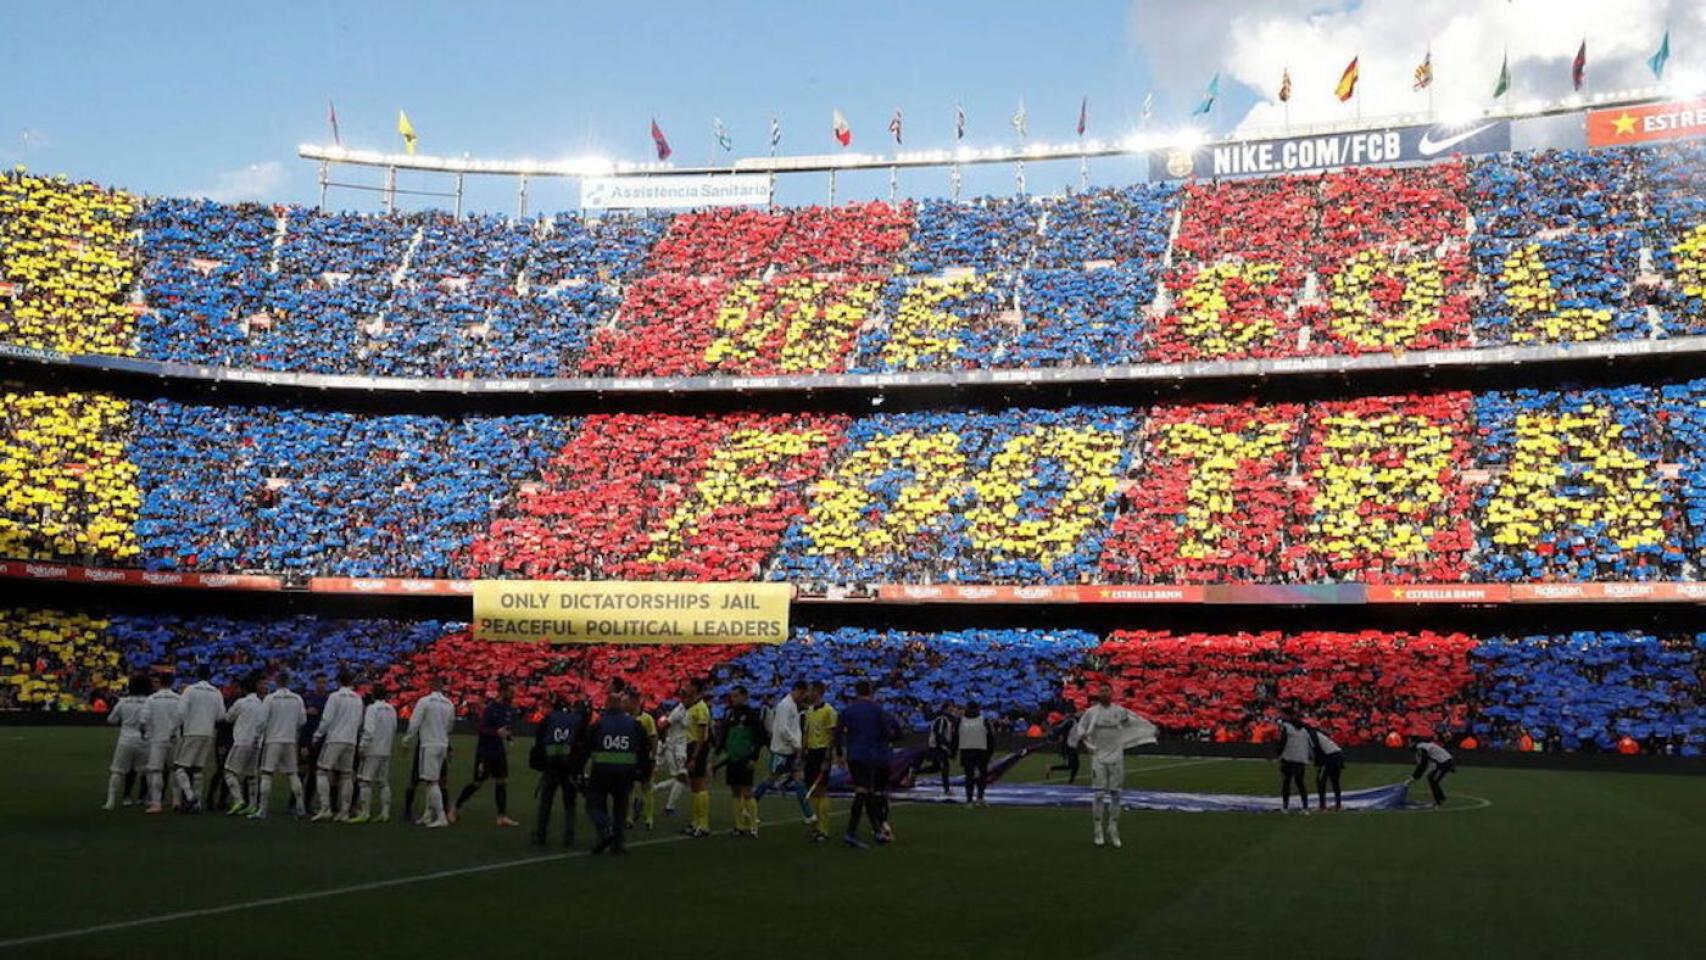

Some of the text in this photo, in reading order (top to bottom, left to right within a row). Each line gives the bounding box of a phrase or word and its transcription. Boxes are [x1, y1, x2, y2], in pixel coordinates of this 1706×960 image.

[1643, 108, 1706, 132] ESTRE
[1213, 130, 1401, 175] NIKE.COM/FCB
[26, 563, 68, 578] Rakuten
[85, 568, 125, 581] Rakuten
[142, 571, 183, 585] Rakuten
[501, 593, 760, 610] ONLY DICTATORSHIPS JAIL
[481, 618, 781, 637] PEACEFUL POLITICAL LEADERS
[603, 734, 630, 750] 045
